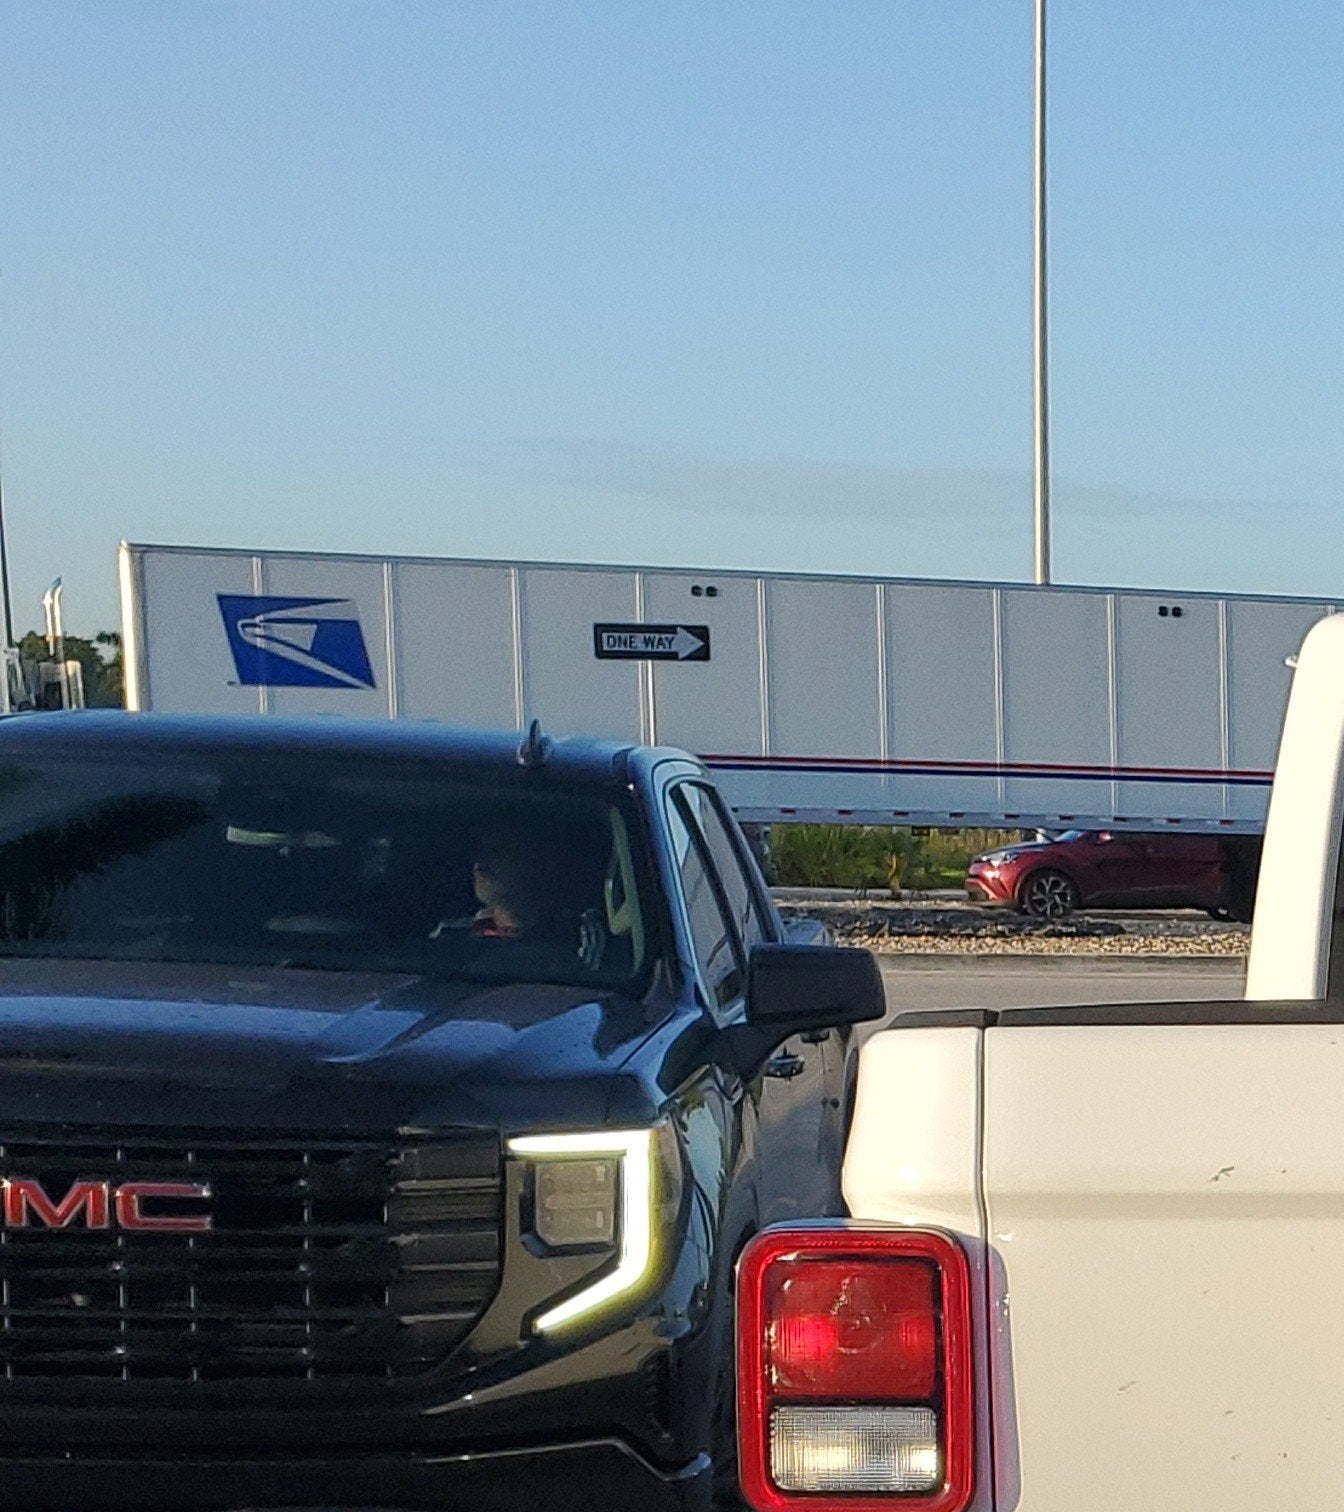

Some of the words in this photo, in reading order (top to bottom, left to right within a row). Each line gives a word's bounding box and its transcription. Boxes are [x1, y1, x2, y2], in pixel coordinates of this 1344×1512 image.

[606, 634, 637, 649] ONE
[643, 636, 675, 650] WAY
[0, 1177, 212, 1230] MC
